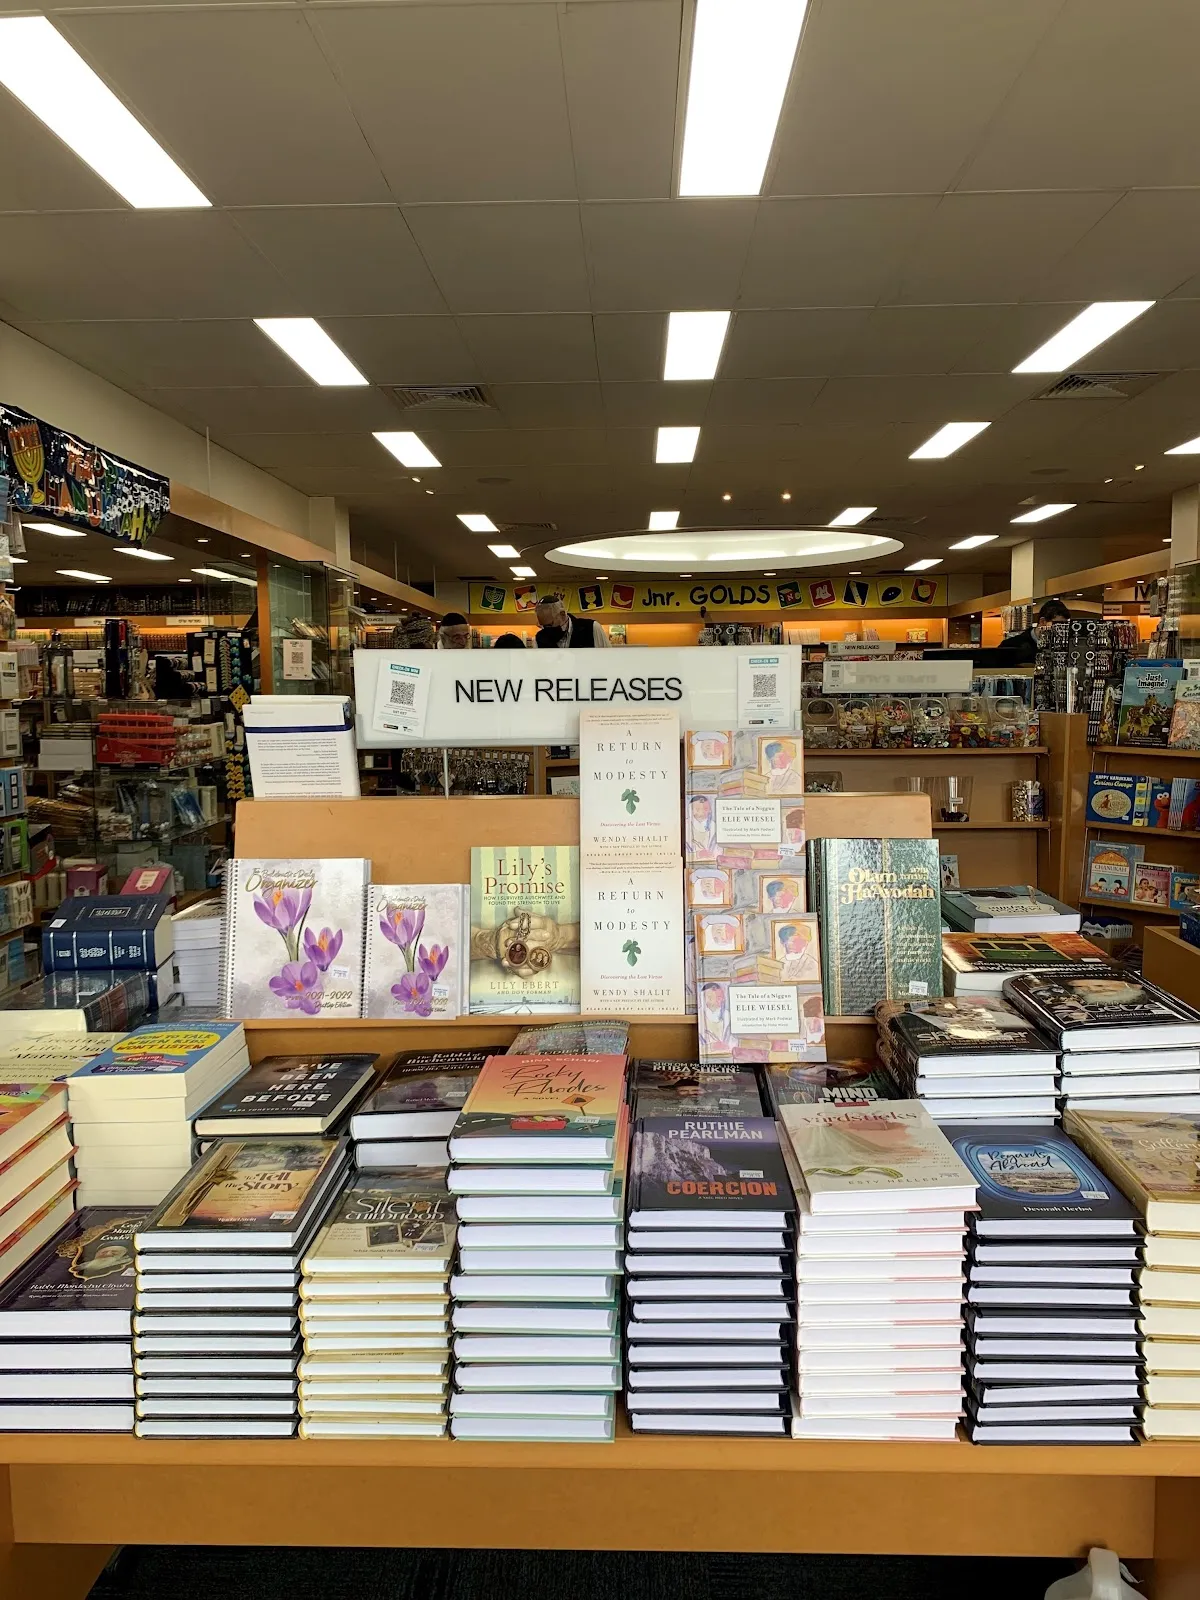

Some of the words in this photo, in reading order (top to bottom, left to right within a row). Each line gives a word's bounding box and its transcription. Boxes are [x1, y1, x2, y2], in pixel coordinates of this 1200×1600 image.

[642, 588, 680, 606] Jnr.
[690, 585, 770, 605] GOLDS
[1146, 673, 1162, 681] Just
[1137, 679, 1168, 688] Imagine!
[455, 679, 522, 702] NEW
[535, 678, 682, 701] RELEASES
[597, 742, 662, 752] RETURN
[593, 770, 668, 781] MODESTY
[1094, 864, 1127, 873] CHANUKAH
[848, 868, 897, 884] Olam
[245, 874, 318, 899] Organizer
[484, 877, 565, 895] Promise
[598, 891, 664, 901] RETURN
[594, 921, 671, 931] MODESTY
[490, 982, 517, 990] LILY
[522, 981, 560, 989] EBERT
[306, 991, 353, 1000] 2021-2022
[406, 1056, 486, 1064] Buchenwald
[294, 1062, 343, 1071] I'VE
[280, 1073, 338, 1081] BEEN
[502, 1064, 584, 1085] Rocky
[268, 1083, 328, 1091] HERE
[502, 1078, 608, 1097] Rhodes
[241, 1094, 332, 1103] BEFORE
[822, 1088, 879, 1099] MIND
[685, 1122, 745, 1131] RUTHIE
[668, 1130, 763, 1140] PEARLMAN
[988, 1150, 1048, 1161] Regards
[990, 1156, 1054, 1171] Abroad
[256, 1172, 292, 1181] Tell
[237, 1182, 300, 1192] Story
[667, 1182, 778, 1196] COERCION
[352, 1196, 448, 1214] Silent
